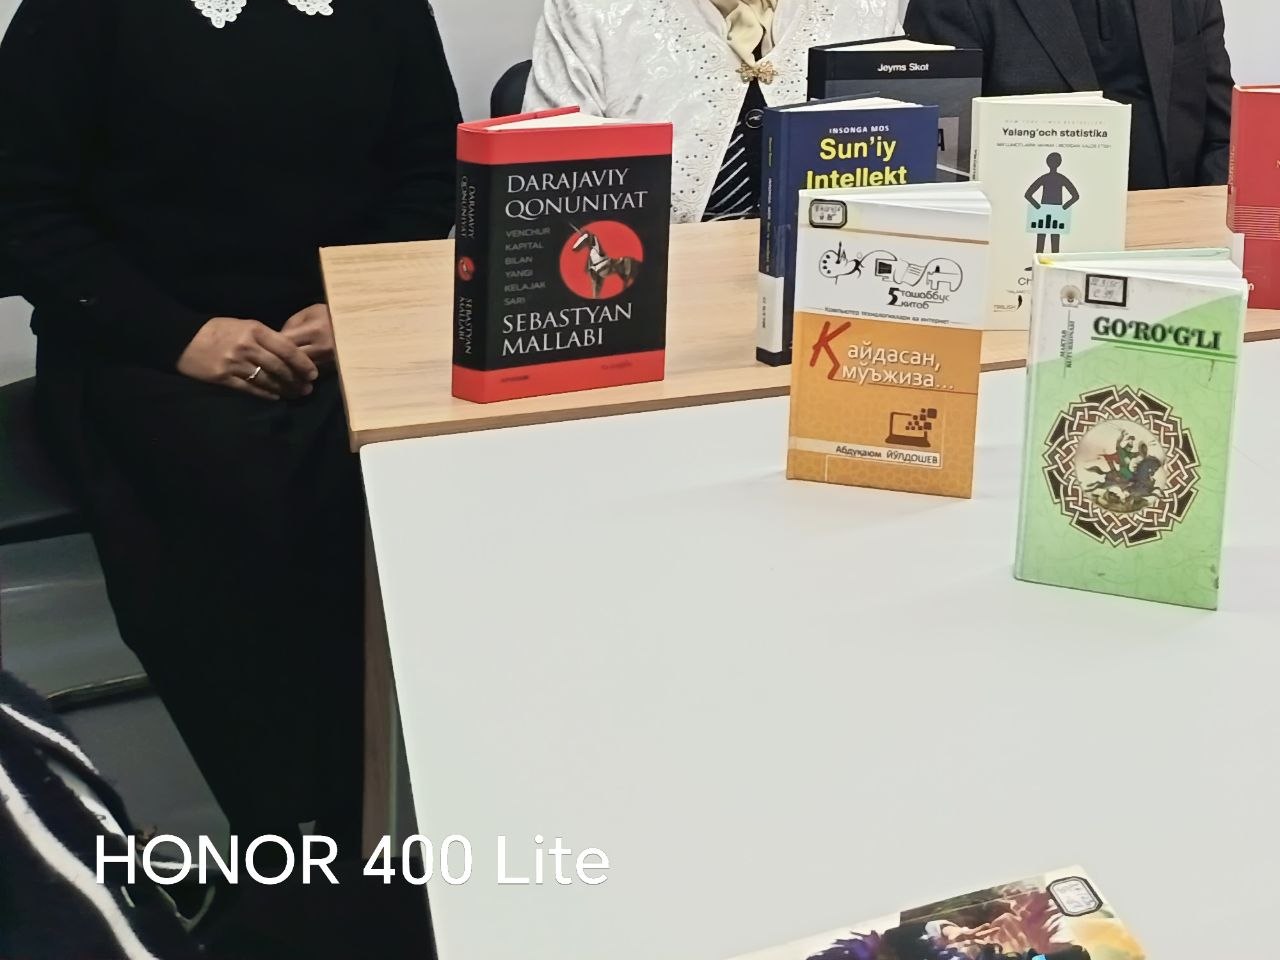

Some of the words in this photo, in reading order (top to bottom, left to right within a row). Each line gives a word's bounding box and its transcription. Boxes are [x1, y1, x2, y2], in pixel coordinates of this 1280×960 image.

[828, 126, 868, 134] INSONGA
[870, 125, 890, 133] MOS
[1059, 128, 1108, 138] statistika
[819, 136, 897, 161] Sun'iy
[507, 167, 629, 194] DARAJAVIY
[806, 166, 908, 189] Intellekt
[505, 191, 648, 220] QONUNIYAT
[505, 227, 551, 238] VENCHUR
[504, 241, 544, 251] KAPITAL
[504, 256, 533, 265] BILAN
[505, 269, 533, 279] YANGI
[504, 281, 546, 293] KELAJAK
[503, 296, 526, 306] SARI
[502, 303, 633, 334] SEBASTYAN
[501, 327, 603, 356] MALLABI
